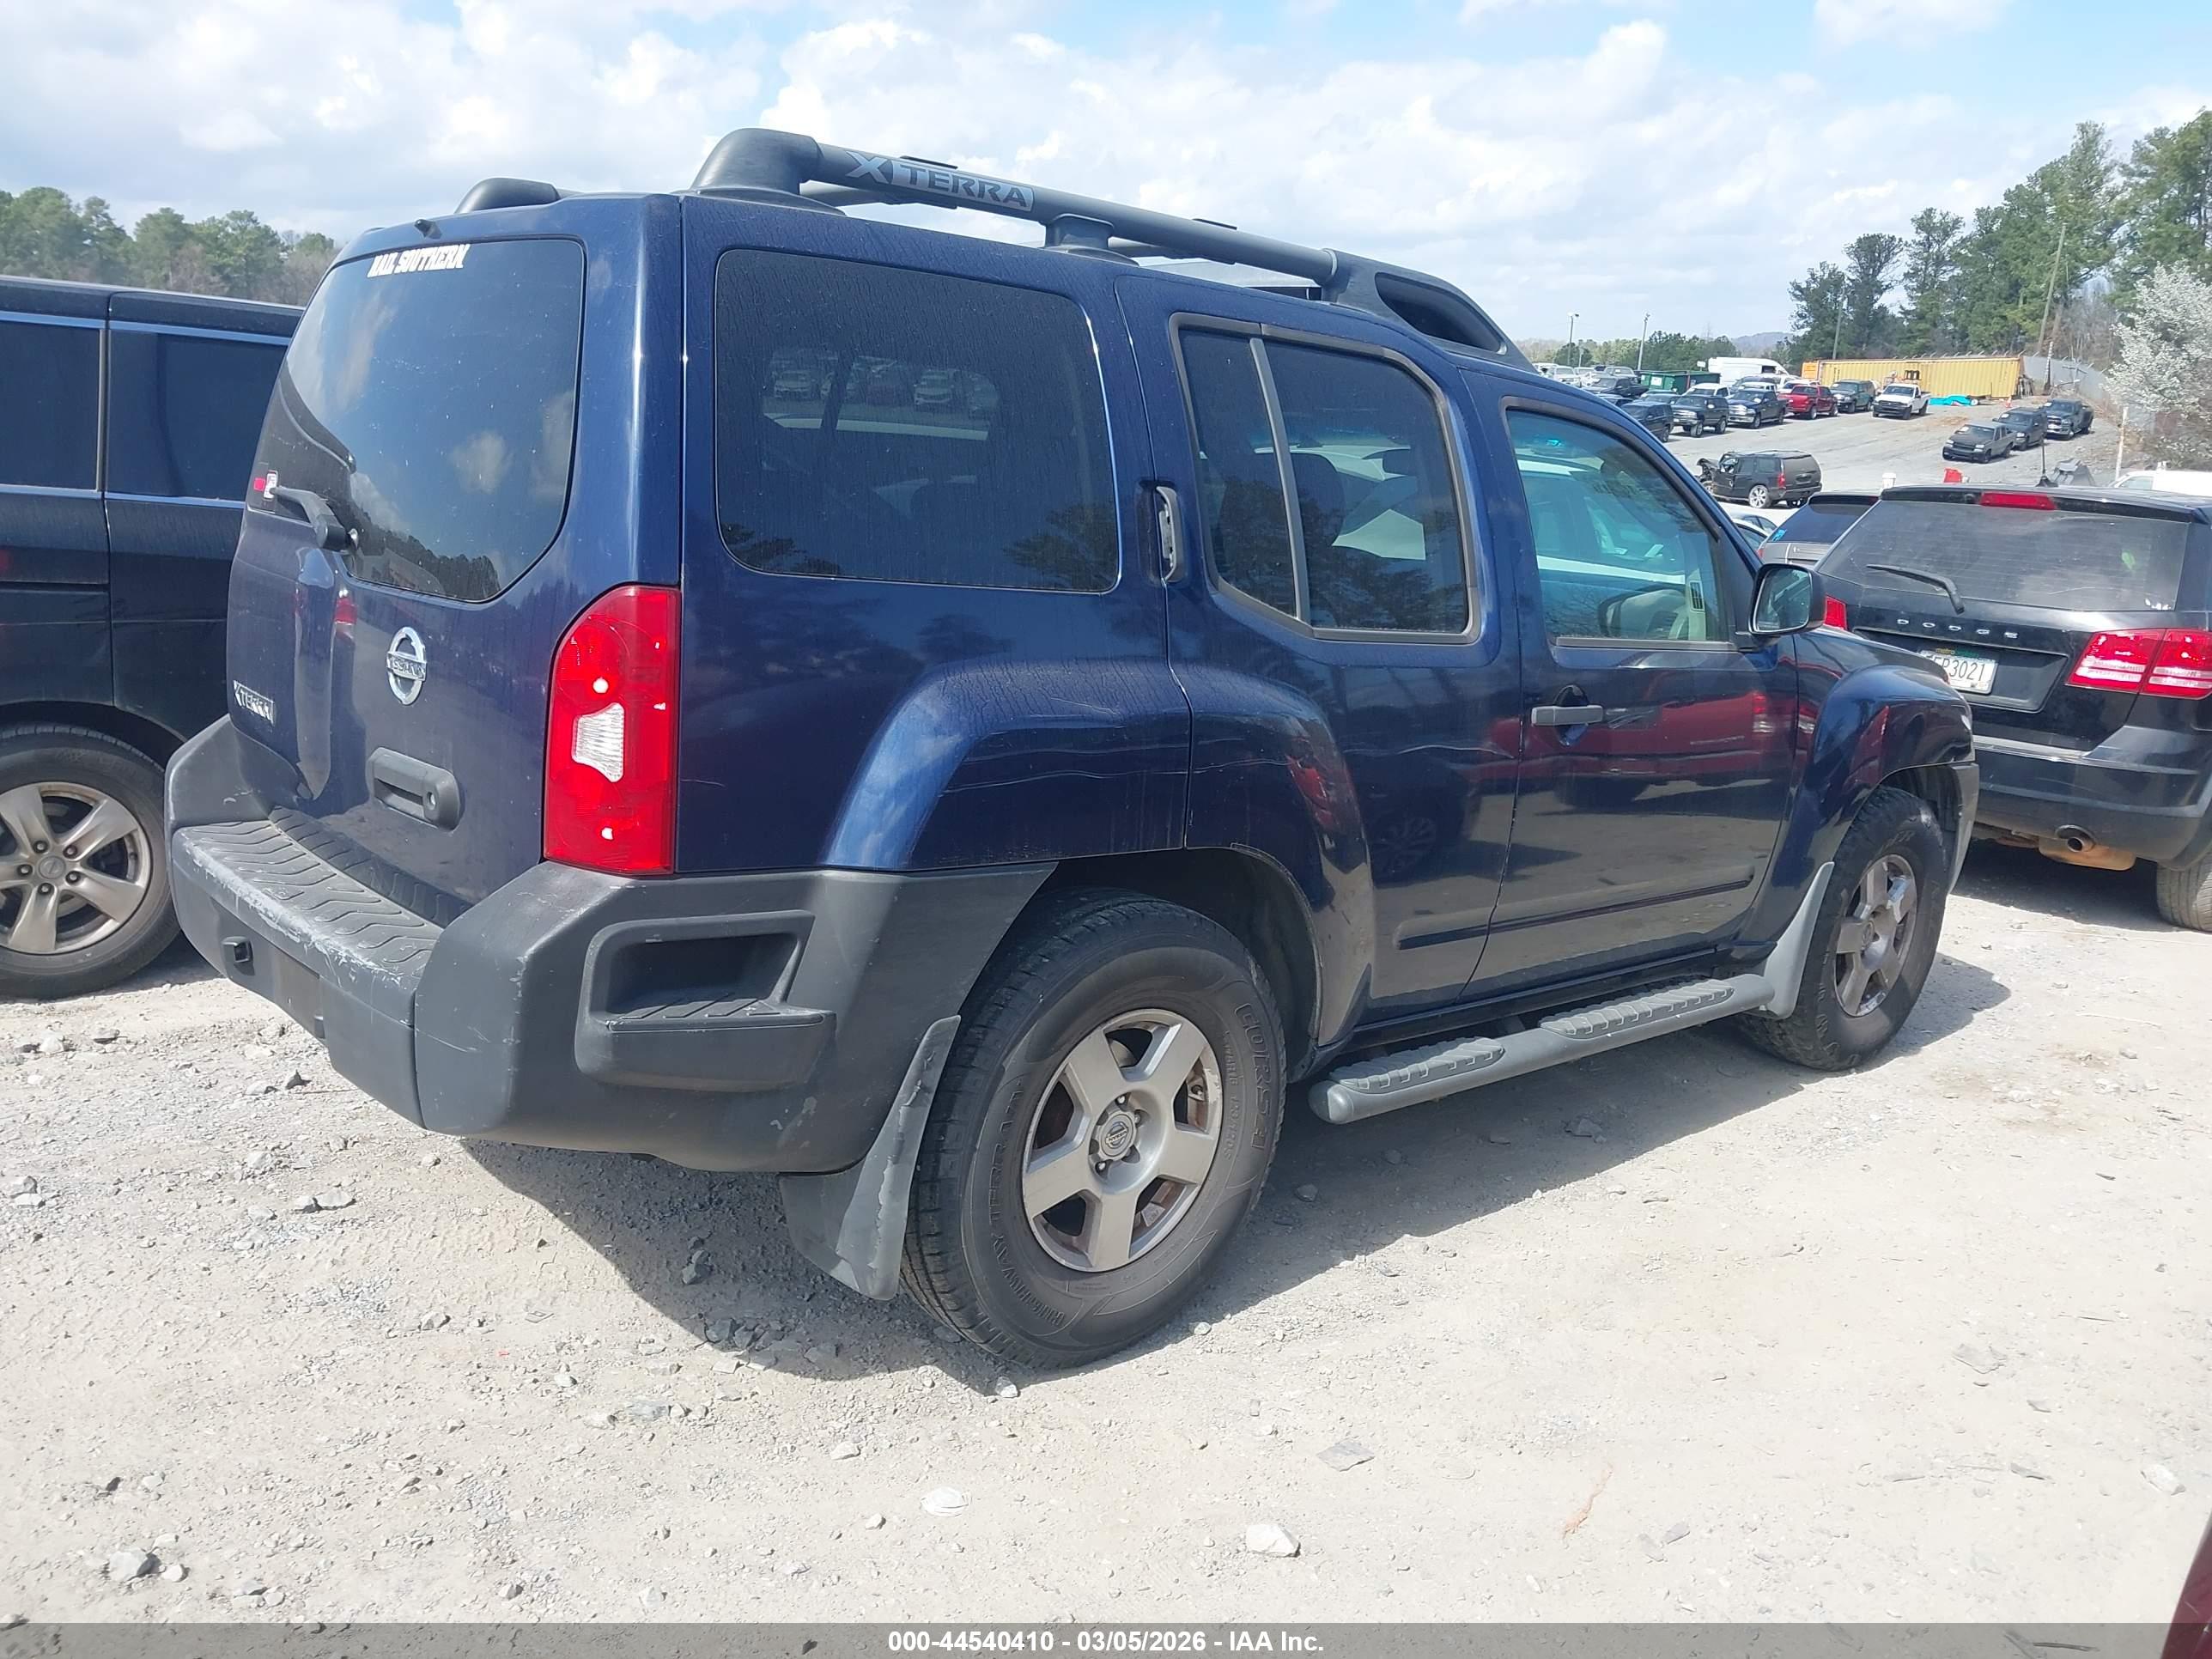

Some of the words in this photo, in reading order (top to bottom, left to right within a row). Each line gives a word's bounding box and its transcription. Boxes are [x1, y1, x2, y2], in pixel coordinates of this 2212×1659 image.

[845, 151, 1029, 208] XTERRA
[393, 243, 471, 273] SOUTHERN
[1897, 617, 2019, 639] DODGE
[1234, 1003, 1271, 1149] CORSA
